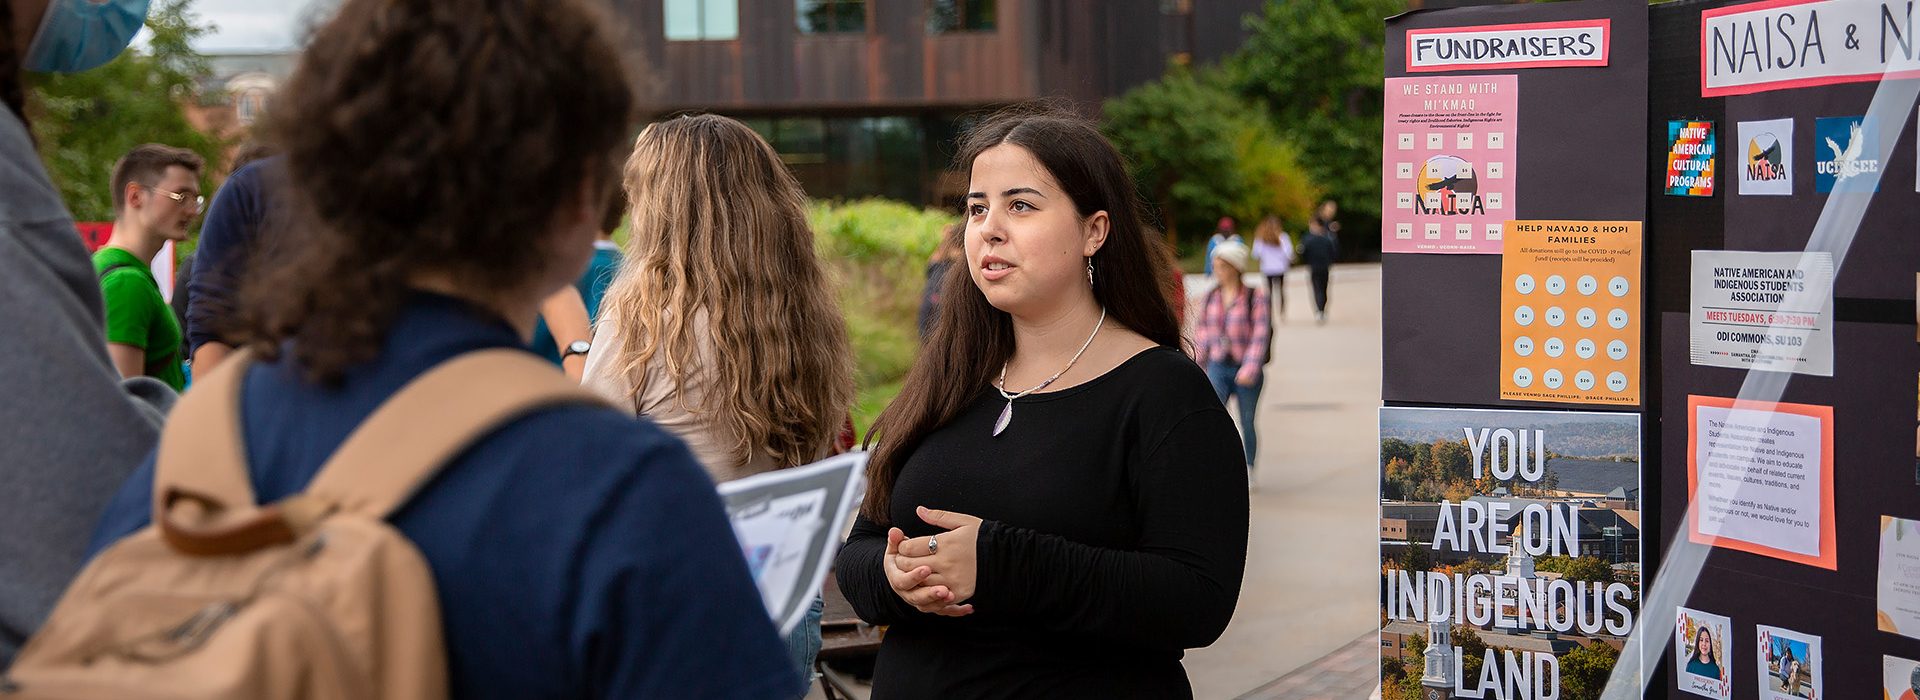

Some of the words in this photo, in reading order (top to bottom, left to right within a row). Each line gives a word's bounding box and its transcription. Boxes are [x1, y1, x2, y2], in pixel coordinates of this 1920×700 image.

[1714, 10, 1826, 76] NAISA
[1845, 23, 1860, 50] &
[1880, 1, 1920, 64] N
[1416, 33, 1596, 61] FUNDRAISERS
[1404, 84, 1420, 95] WE
[1425, 84, 1462, 94] STAND
[1469, 82, 1498, 94] WITH
[1424, 99, 1475, 110] MI'KMAQ
[1680, 128, 1706, 139] NATIVE
[1672, 144, 1712, 155] AMERICAN
[1672, 160, 1710, 171] CULTURAL
[1746, 164, 1786, 181] NAISA
[1670, 175, 1712, 188] PROGRAMS
[1714, 267, 1740, 278] NATIVE
[1742, 268, 1785, 279] AMERICAN
[1786, 270, 1804, 279] AND
[1714, 280, 1759, 290] INDIGENOUS
[1760, 281, 1804, 292] STUDENTS
[1731, 292, 1785, 303] ASSOCIATION
[1707, 311, 1727, 321] MEETS
[1729, 312, 1767, 324] TUESDAYS,
[1802, 317, 1815, 326] PM
[1717, 332, 1730, 341] ODI
[1731, 332, 1774, 345] COMMONS,
[1775, 336, 1786, 345] SU
[1787, 337, 1802, 346] 103
[1767, 427, 1794, 437] Indigenous
[1463, 427, 1544, 482] YOU
[1776, 450, 1804, 459] Indigenous
[1782, 460, 1803, 470] educate
[1769, 469, 1786, 478] related
[1787, 471, 1805, 480] current
[1739, 498, 1756, 510] identify
[1764, 504, 1779, 513] Native
[1740, 510, 1750, 518] not,
[1760, 514, 1774, 522] would
[1774, 515, 1786, 524] love
[1793, 519, 1803, 527] you
[1804, 520, 1810, 528] to
[1432, 500, 1510, 554] ARE
[1522, 503, 1579, 558] ON
[1387, 569, 1633, 636] INDIGENOUS
[1454, 646, 1560, 700] LAND
